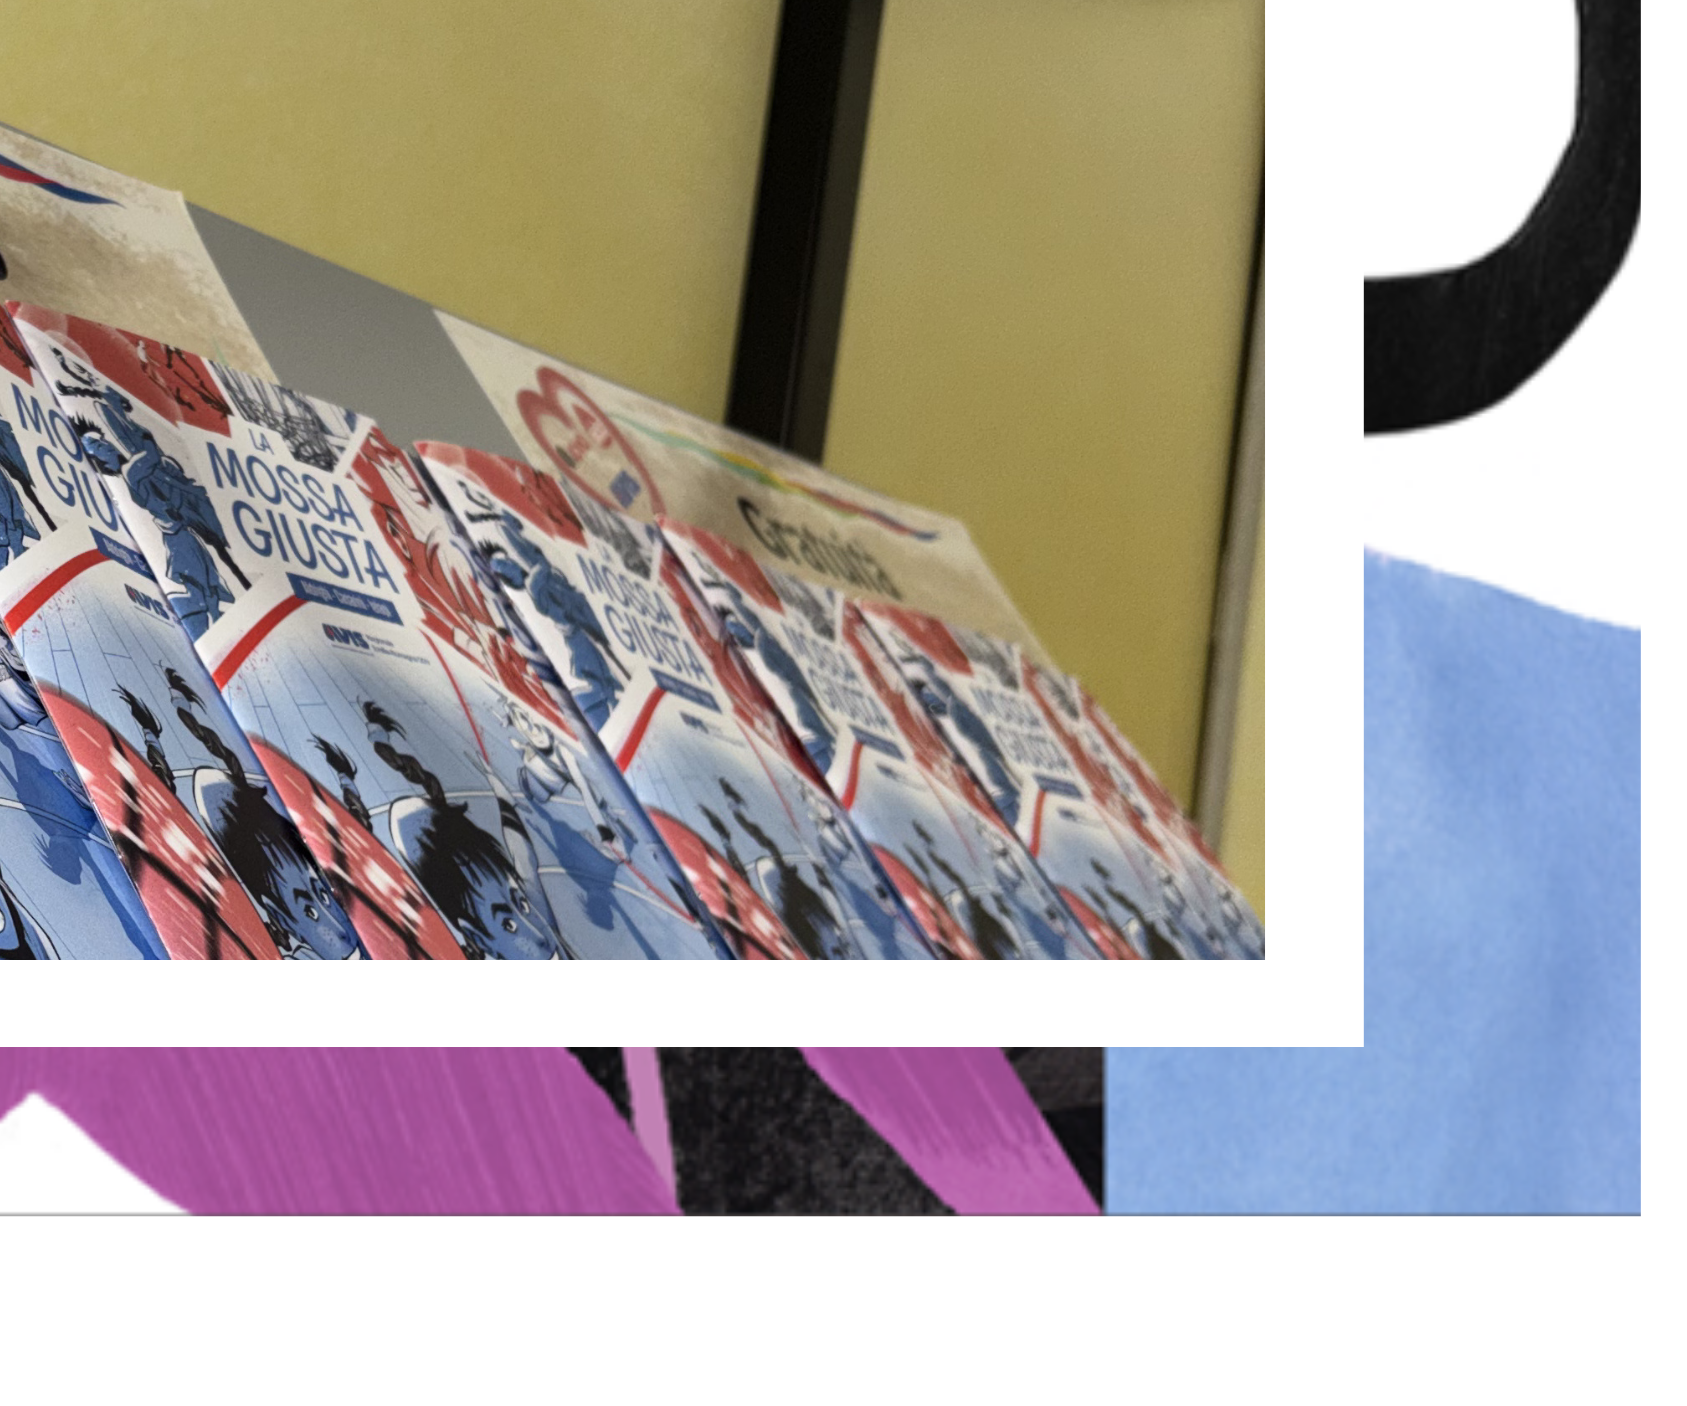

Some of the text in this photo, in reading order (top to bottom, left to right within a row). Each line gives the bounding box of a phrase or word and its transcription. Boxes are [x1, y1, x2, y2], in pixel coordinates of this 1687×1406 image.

[247, 428, 274, 455] LA
[206, 442, 365, 532] MOSSA
[232, 501, 399, 594] GIUSTA
[576, 553, 681, 634] MOSSA
[604, 604, 713, 687] GIUSTA
